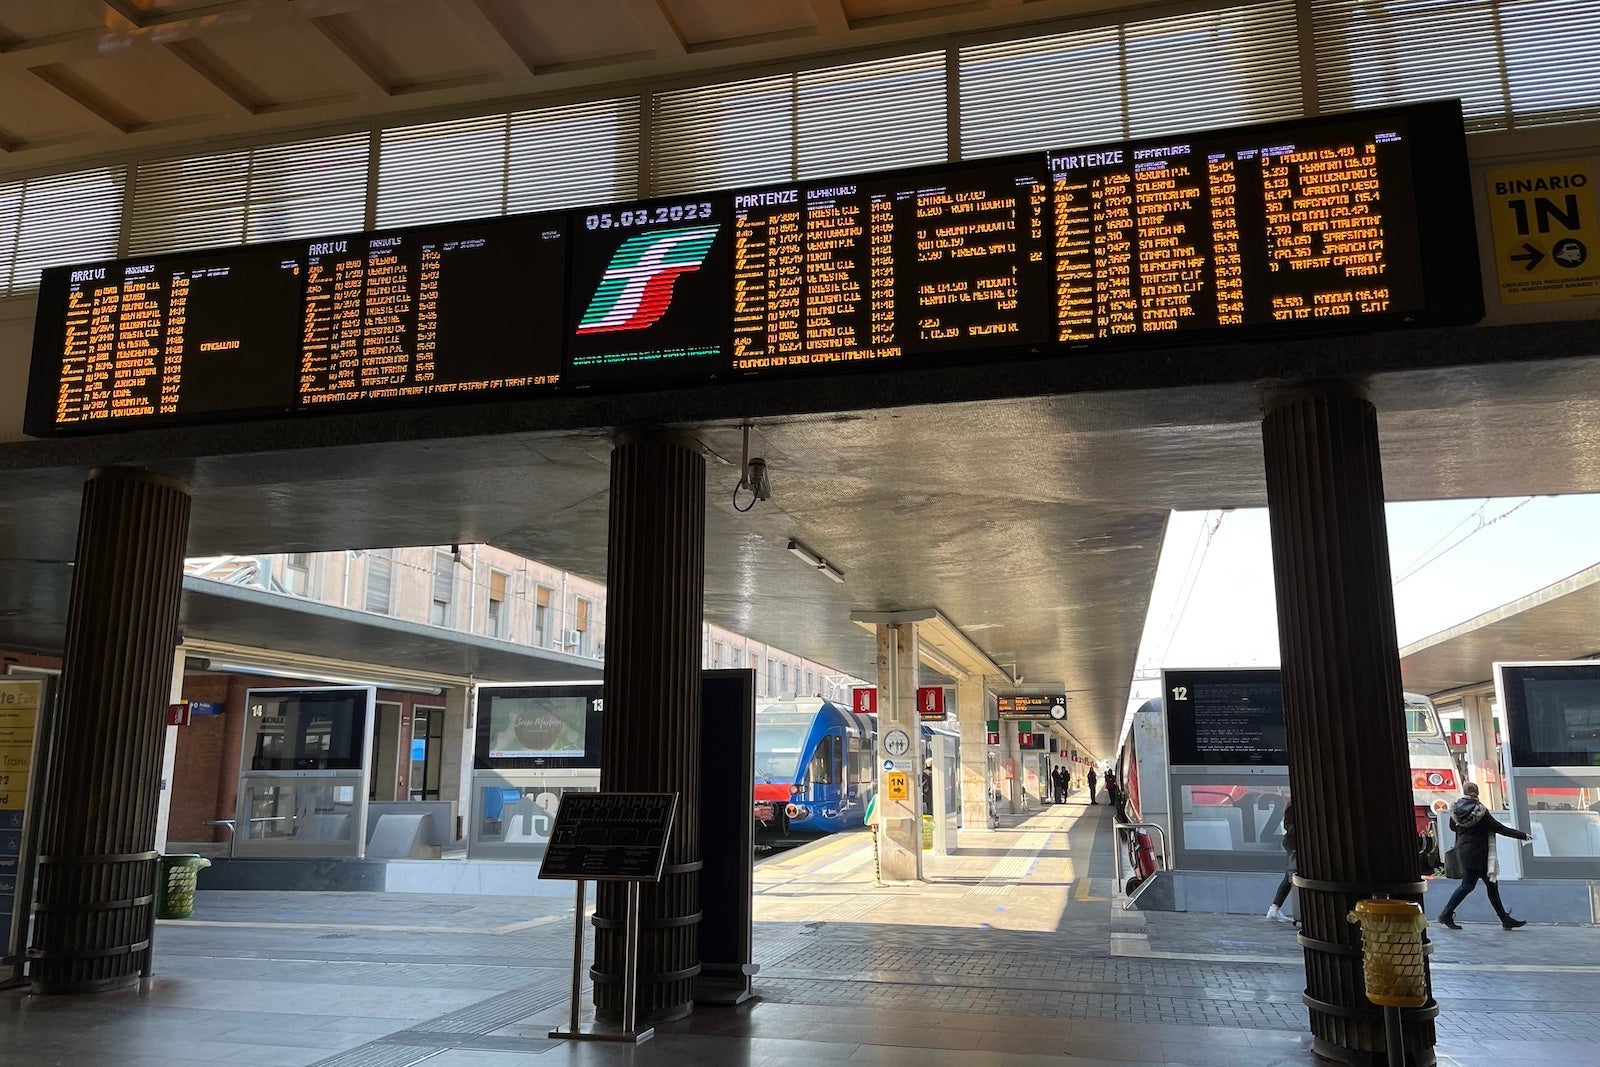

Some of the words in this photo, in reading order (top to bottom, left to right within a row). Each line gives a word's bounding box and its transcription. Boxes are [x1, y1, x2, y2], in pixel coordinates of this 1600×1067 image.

[1134, 145, 1190, 159] DEPARTURES
[1052, 151, 1123, 170] PARTENZE
[1495, 174, 1587, 195] BINARIO
[736, 190, 798, 208] PARTENZE
[808, 186, 856, 199] DEPARTURES
[586, 203, 712, 230] 05.03.2023
[1508, 195, 1580, 235] 1N
[309, 241, 347, 255] ARRIVI
[71, 268, 105, 282] ARRIVI
[1172, 686, 1188, 700] 12
[251, 704, 263, 716] 14
[592, 699, 603, 711] 13
[1233, 793, 1289, 843] 12
